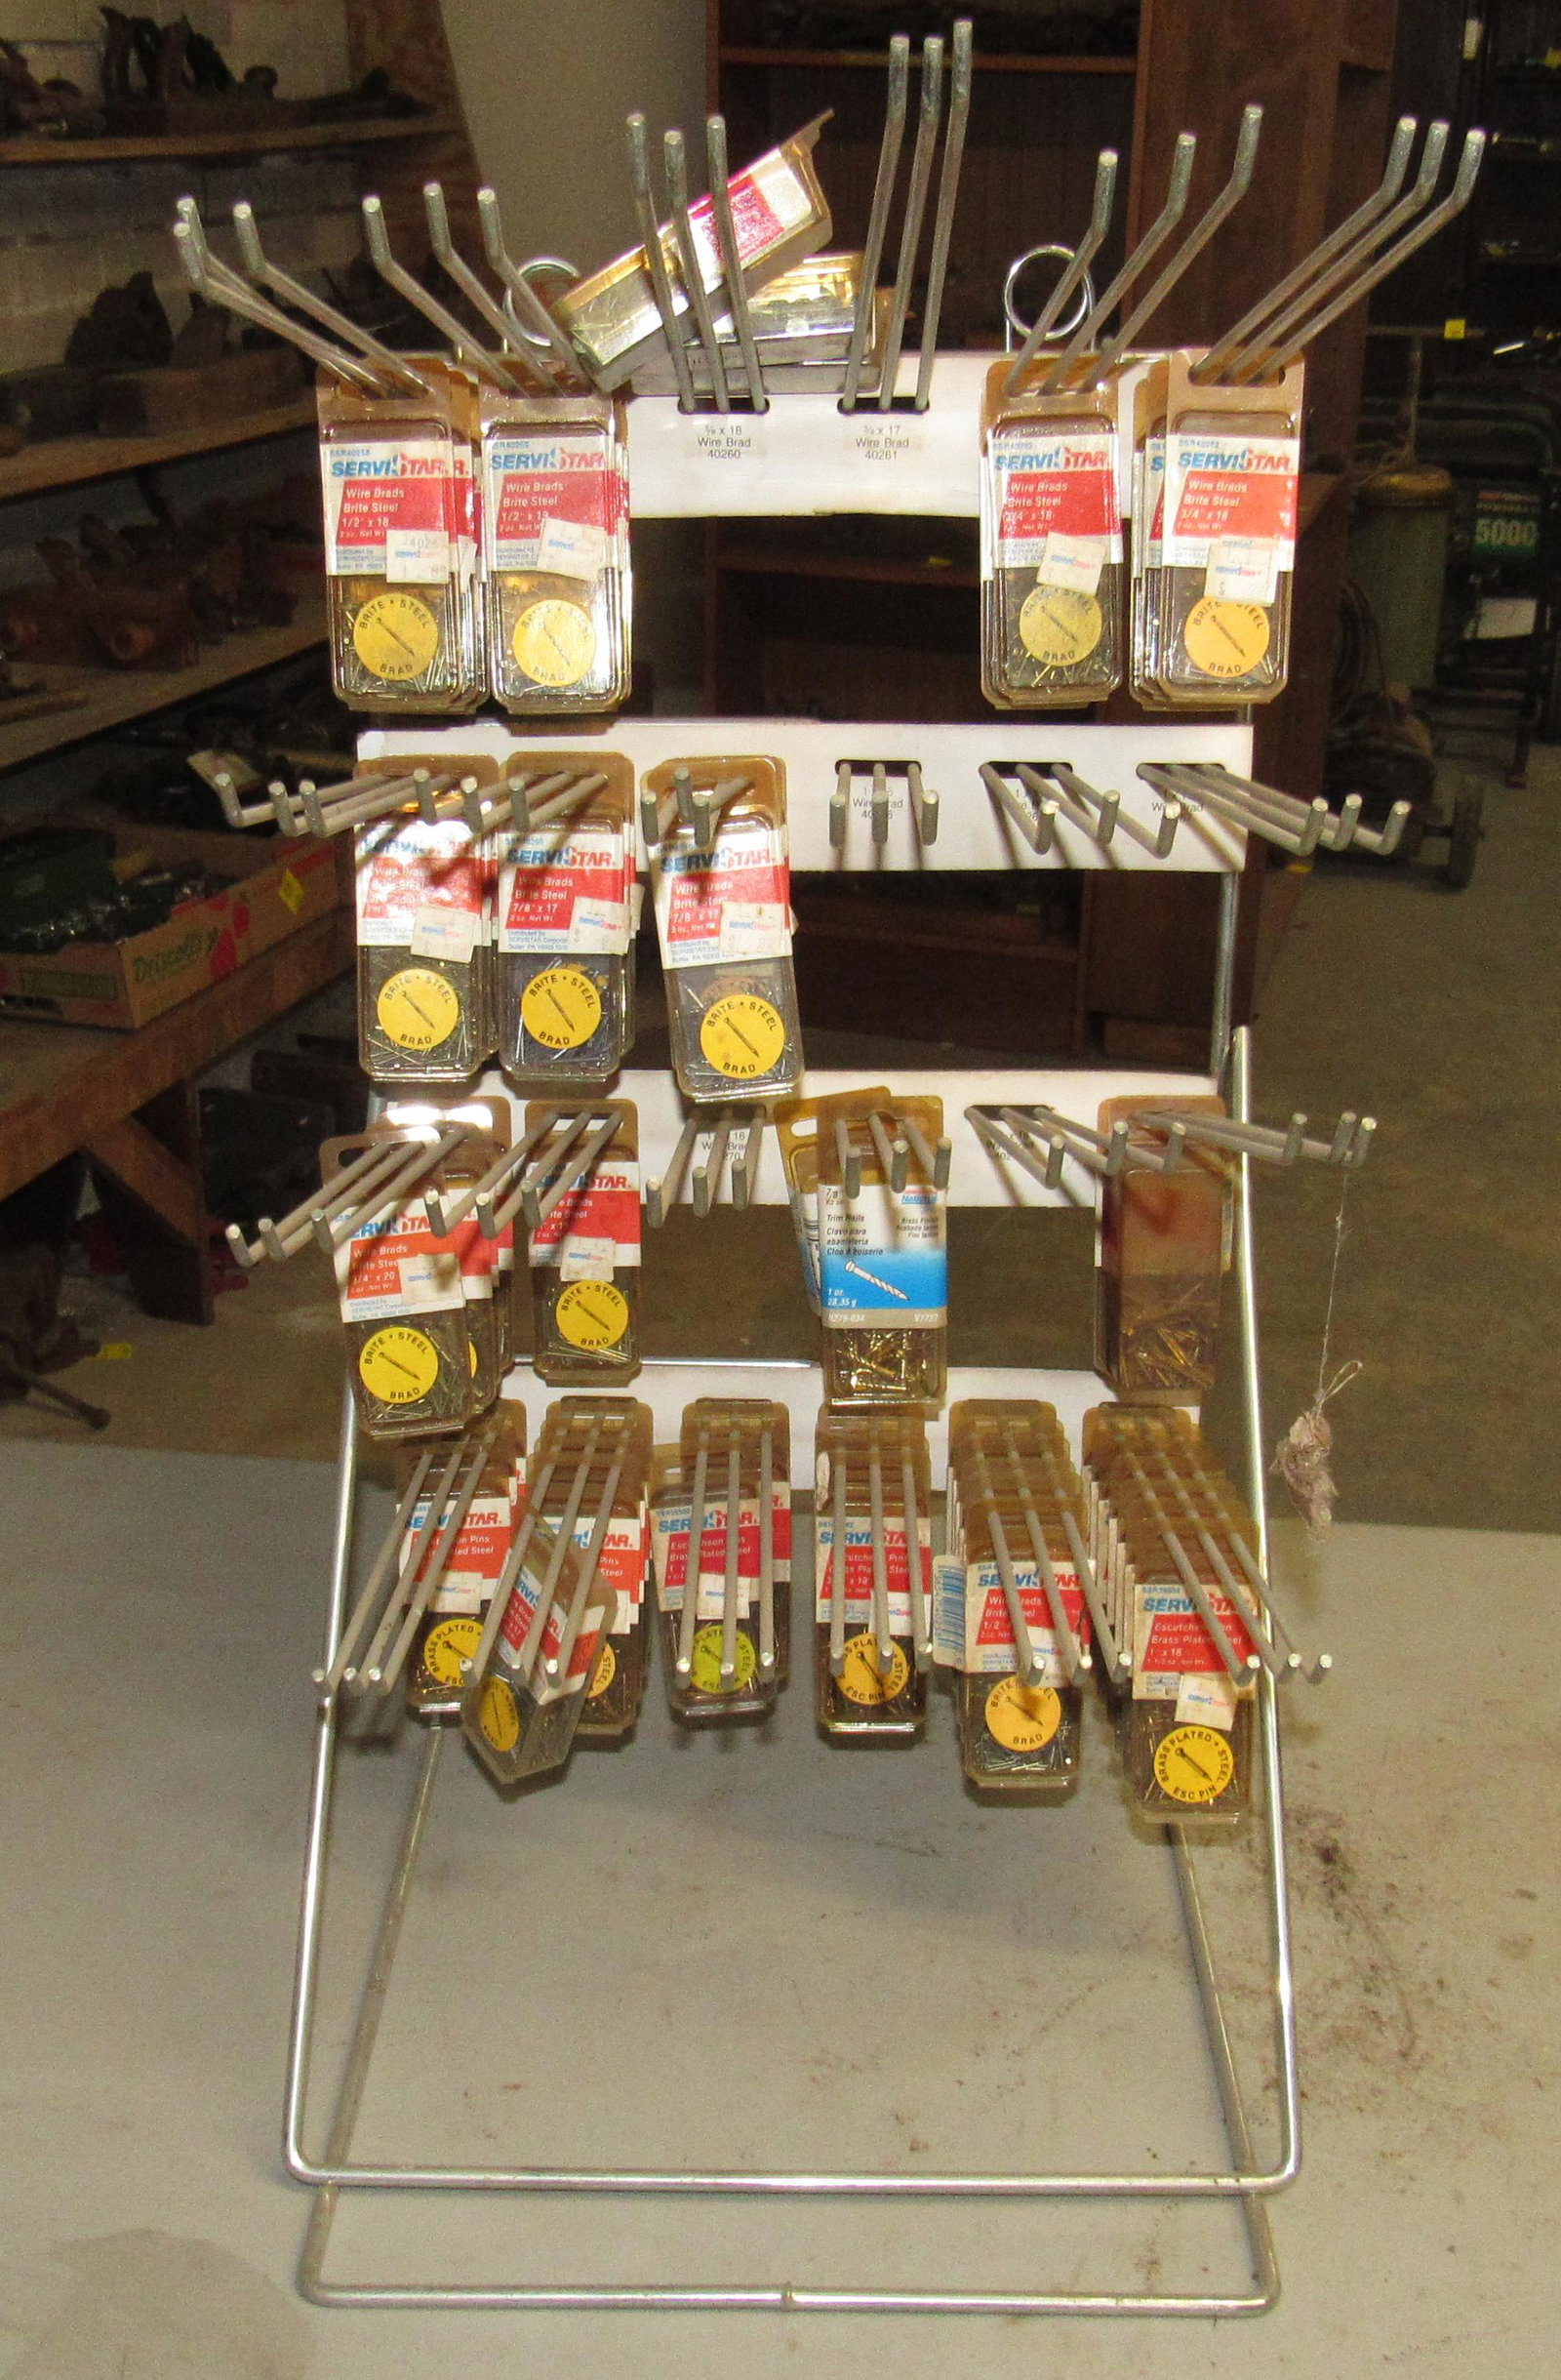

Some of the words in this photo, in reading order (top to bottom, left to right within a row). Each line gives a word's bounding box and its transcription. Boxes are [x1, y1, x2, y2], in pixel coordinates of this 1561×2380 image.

[730, 425, 742, 435] 18
[889, 425, 901, 435] 17
[698, 437, 722, 447] Wire
[726, 437, 751, 447] Brad
[856, 437, 880, 448] Wire
[884, 437, 909, 448] Brad
[706, 449, 741, 459] 40260
[864, 449, 899, 460] 40261
[506, 483, 531, 493] Wire
[534, 482, 564, 492] Brads
[1011, 483, 1034, 493] Wire
[1038, 482, 1068, 492] Brads
[1189, 480, 1214, 491] Wire
[1216, 482, 1248, 493] Brads
[345, 488, 371, 499] Wire
[375, 487, 405, 499] Brads
[503, 498, 529, 507] Brite
[532, 496, 558, 506] Steel
[1035, 496, 1061, 506] Steel
[1183, 495, 1210, 505] Brite
[1213, 497, 1240, 507] Steel
[343, 503, 369, 513] Brite
[372, 502, 399, 513] Steel
[378, 518, 390, 528] 18
[359, 602, 385, 629] BRITE
[400, 599, 429, 628] STEEL
[1194, 600, 1221, 626] BRITE
[1043, 650, 1075, 661] BRAD
[380, 664, 414, 674] BRAD
[1208, 664, 1243, 675] BRAD
[544, 877, 574, 887] Brads
[541, 890, 568, 900] Steel
[675, 884, 700, 895] Wire
[546, 904, 558, 913] 17
[673, 899, 697, 909] Brite
[384, 976, 412, 1000] BRITE
[425, 976, 452, 1005] STEEL
[529, 975, 558, 997] BRITE
[571, 978, 596, 1009] STEEL
[707, 1001, 735, 1028] BRITE
[748, 1001, 779, 1031] STEEL
[400, 1033, 432, 1045] BRAD
[539, 1031, 571, 1046] BRAD
[722, 1062, 756, 1074] BRAD
[735, 1132, 745, 1141] 16
[380, 1245, 408, 1255] Brads
[379, 1257, 400, 1269] Stee
[384, 1271, 396, 1281] 20
[561, 1286, 582, 1311] BRITE
[594, 1284, 621, 1308] STEEL
[852, 1299, 857, 1308] g
[580, 1336, 610, 1347] BRAD
[364, 1337, 386, 1364] BRITE
[398, 1332, 430, 1354] STEEL
[390, 1388, 420, 1399] BRAD
[470, 1534, 490, 1543] Pins
[471, 1546, 495, 1554] Steel
[702, 1549, 725, 1558] lated
[601, 1568, 623, 1577] Steel
[1021, 1596, 1042, 1606] rads
[1151, 1635, 1180, 1644] Brass
[427, 1641, 441, 1673] BRASS
[435, 1625, 474, 1639] PLATED
[1171, 1648, 1182, 1657] 18
[597, 1656, 611, 1684] STEEL
[889, 1662, 905, 1692] STEEL
[991, 1680, 1013, 1708] BRITE
[1013, 1733, 1043, 1745] BRAD
[1159, 1746, 1171, 1782] BRASS
[1169, 1731, 1212, 1746] PLATED
[1217, 1749, 1229, 1782] STEEL
[1173, 1786, 1195, 1799] ESC
[1198, 1785, 1217, 1798] PIN
